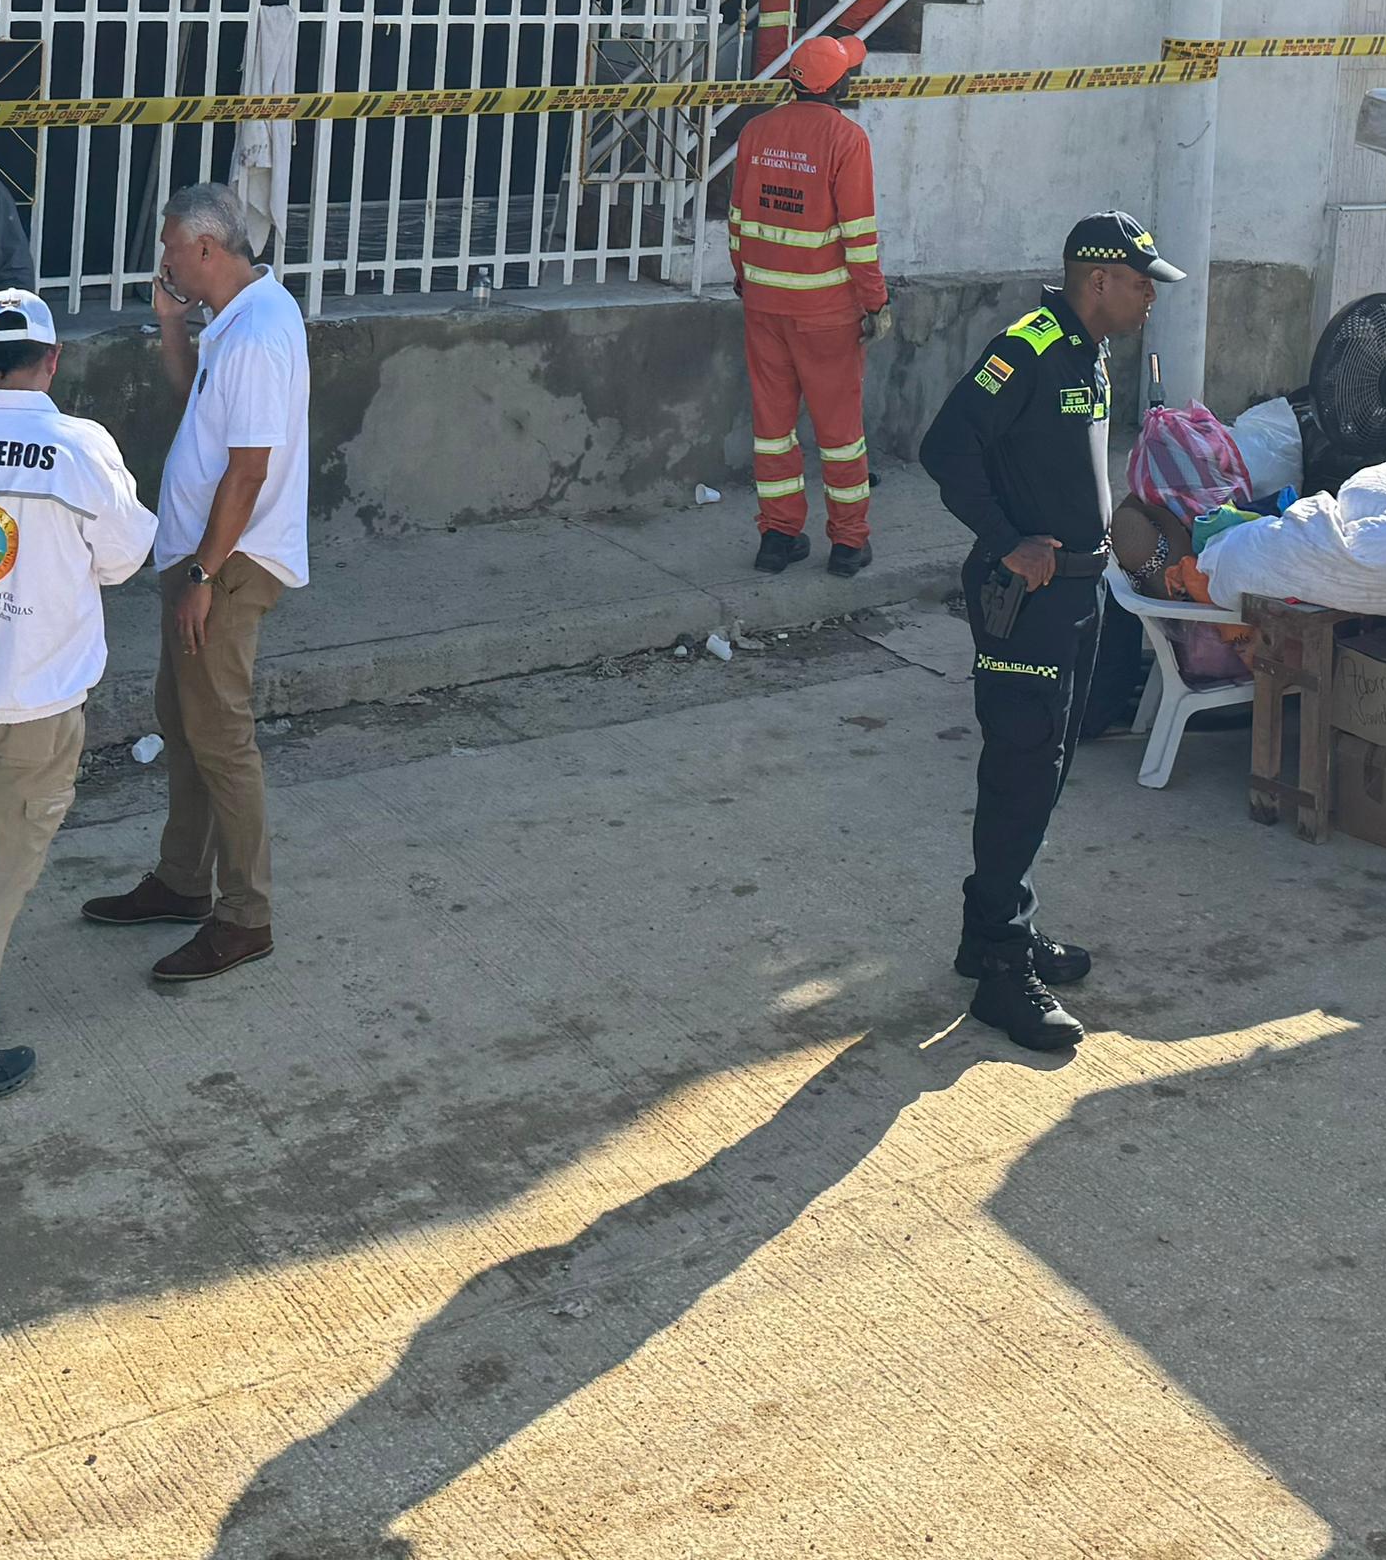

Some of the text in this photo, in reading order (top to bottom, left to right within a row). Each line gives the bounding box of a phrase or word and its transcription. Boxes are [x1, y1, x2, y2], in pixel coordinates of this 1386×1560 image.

[9, 109, 107, 121] PELIGRO NO PASE
[3, 603, 34, 615] INDIAS
